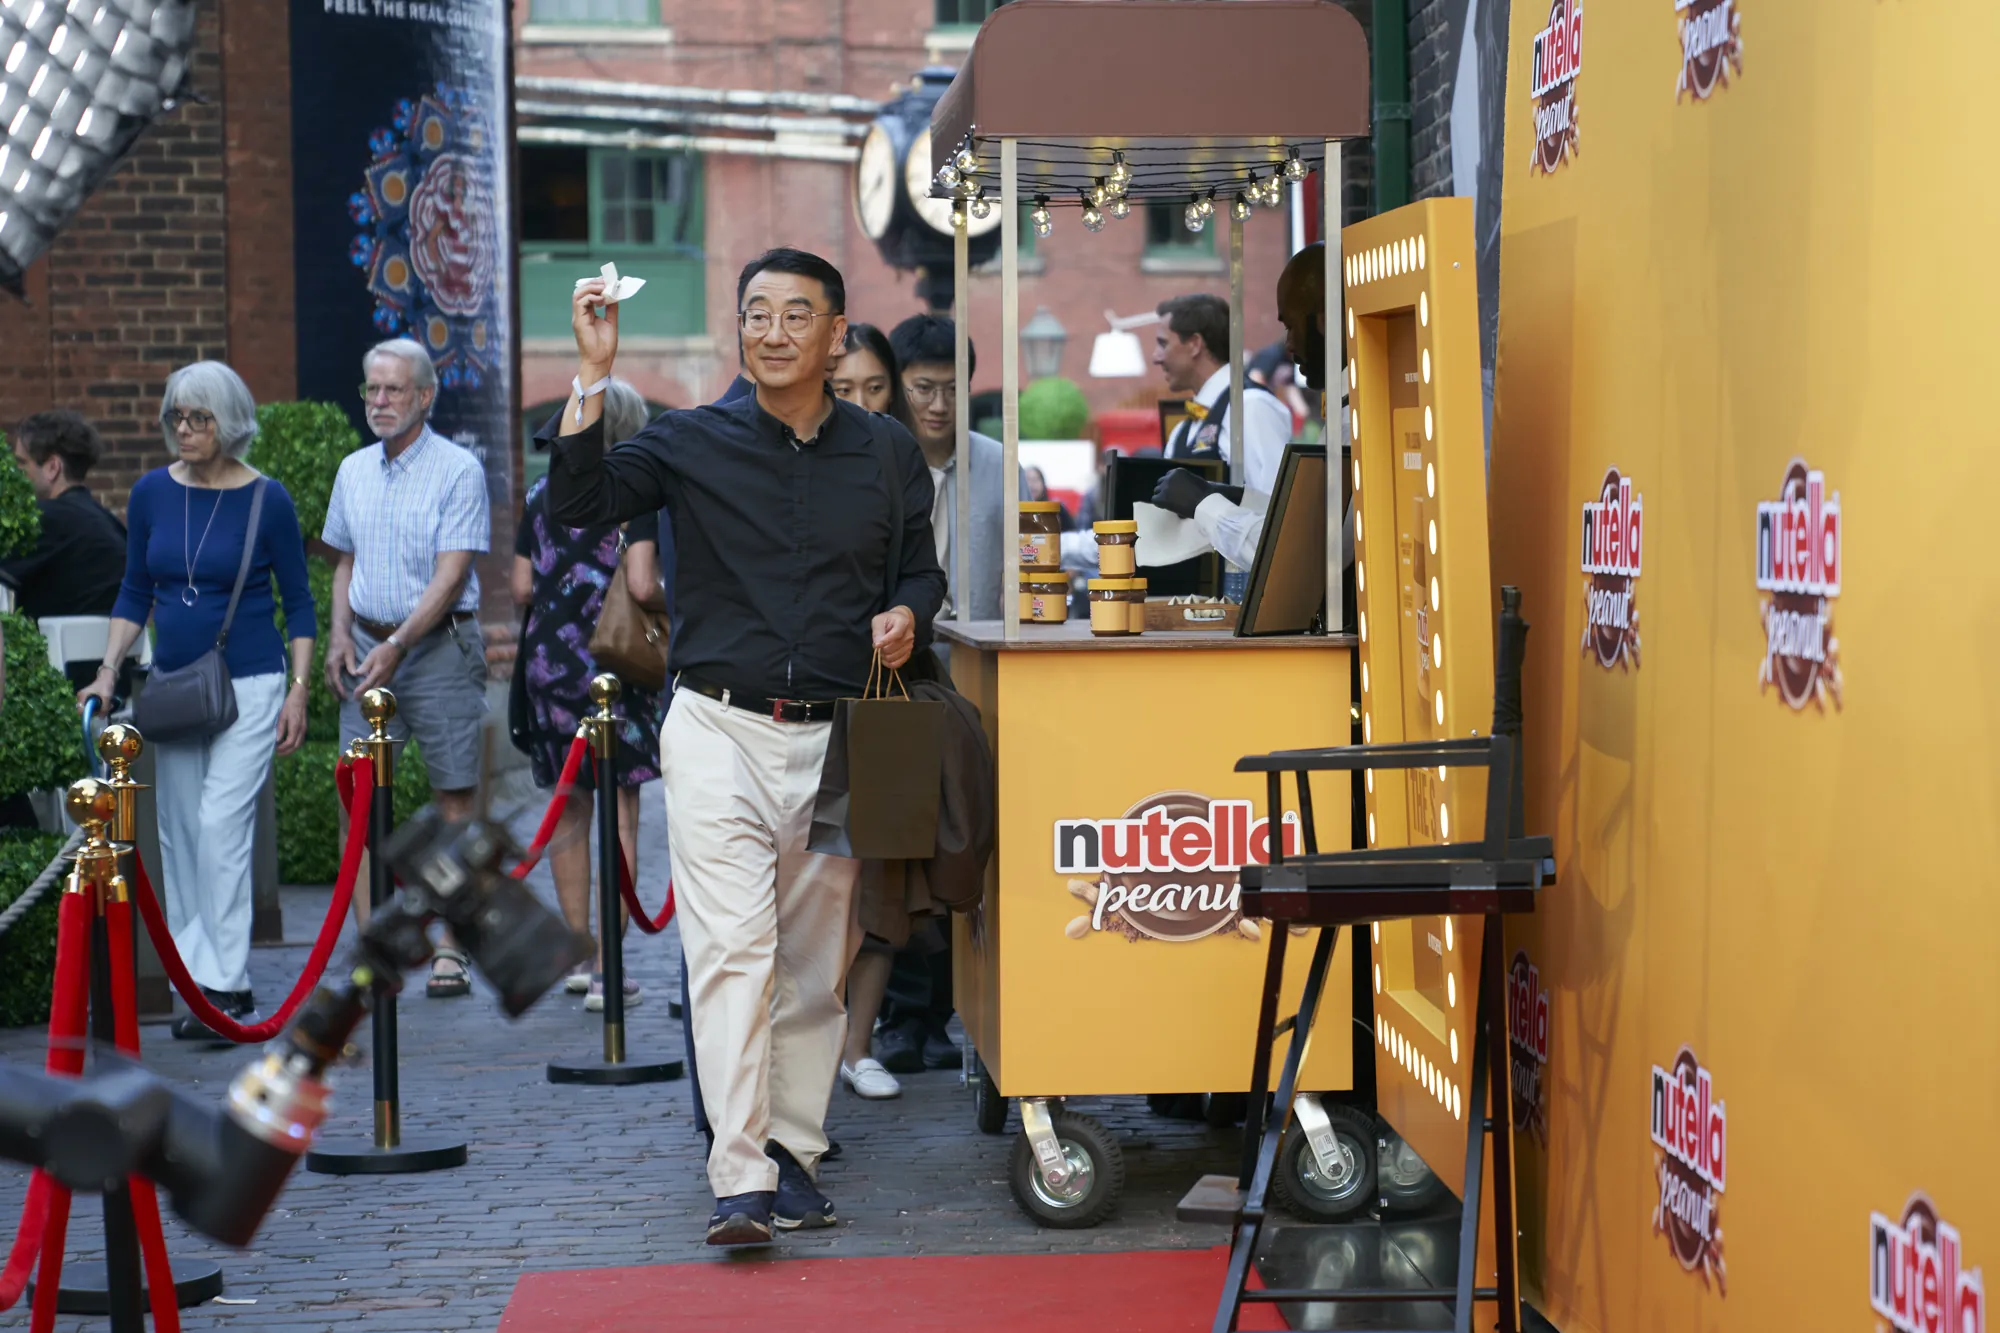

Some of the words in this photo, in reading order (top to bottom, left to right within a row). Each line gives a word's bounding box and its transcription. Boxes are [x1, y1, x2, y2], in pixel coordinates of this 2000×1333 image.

[372, 0, 405, 19] THE
[408, 3, 448, 25] REAL
[1532, 0, 1582, 94] nutella
[1535, 82, 1573, 165] peanut
[1582, 481, 1641, 572] nutella
[1759, 478, 1839, 588] nutella
[1587, 578, 1631, 648] peanut
[1766, 597, 1826, 683] peanut
[1058, 803, 1297, 869] nutella
[1092, 882, 1240, 931] peanu
[1652, 1069, 1724, 1184] nutella
[1659, 1162, 1712, 1242] peanut
